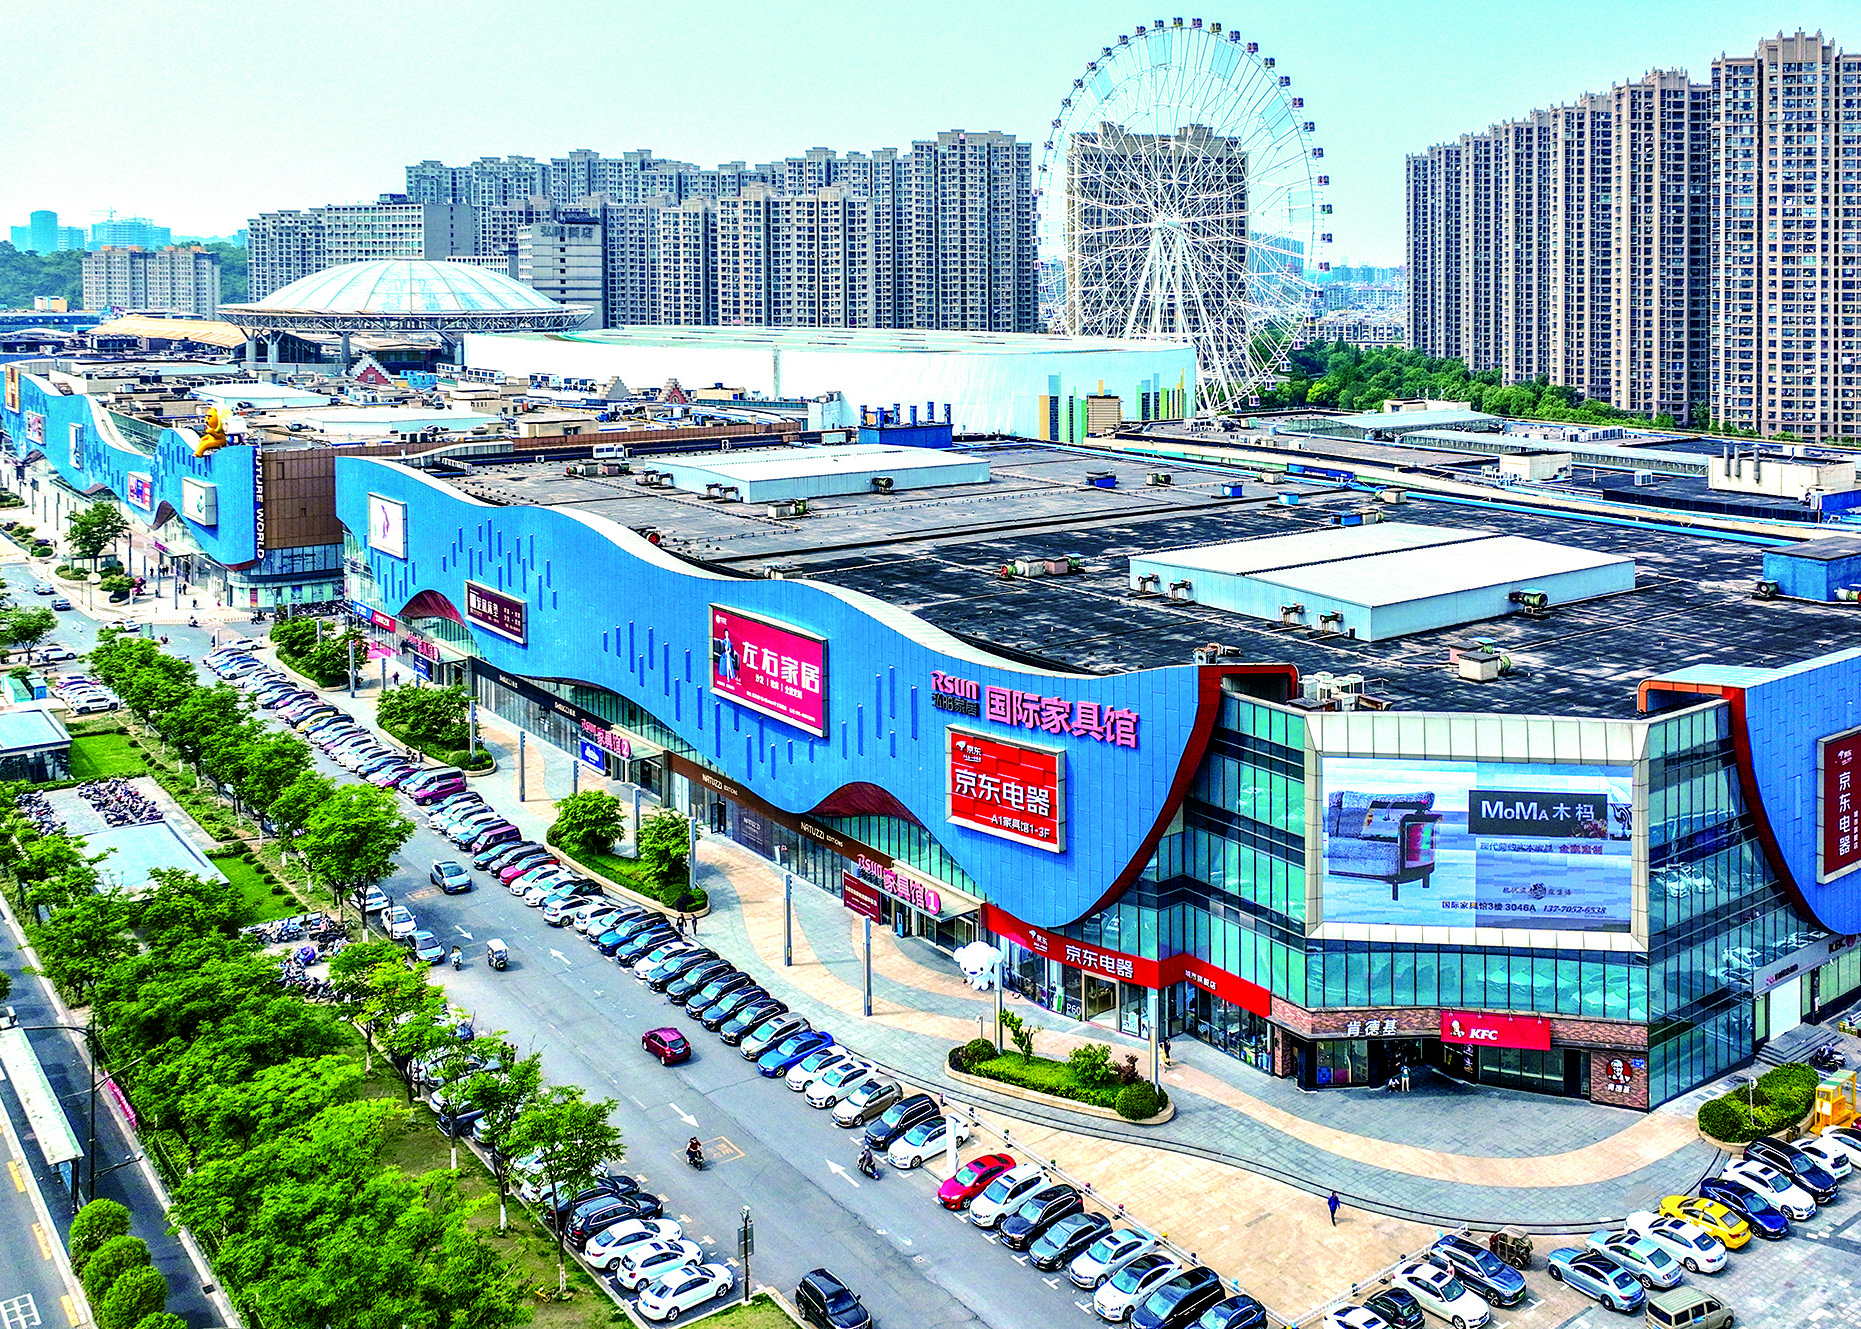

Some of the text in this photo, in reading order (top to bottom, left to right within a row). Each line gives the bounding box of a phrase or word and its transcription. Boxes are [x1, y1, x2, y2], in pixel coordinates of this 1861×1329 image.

[255, 448, 265, 559] FUTURE WORLD
[742, 641, 820, 694] 左右家居
[930, 670, 979, 700] Rsun
[985, 685, 1139, 749] 国际家具馆
[597, 727, 621, 755] 家具馆
[702, 773, 723, 790] NATUZZI
[955, 769, 1050, 817] 京东电器
[1839, 771, 1851, 856] 京东电器
[801, 821, 825, 840] NATUZZI
[883, 867, 926, 909] 家具馆
[1505, 903, 1537, 912] 3046A
[1065, 944, 1134, 979] 京东电器
[1066, 1003, 1082, 1016] P60
[1346, 1018, 1398, 1038] 肯德基
[1469, 1028, 1498, 1041] KFC
